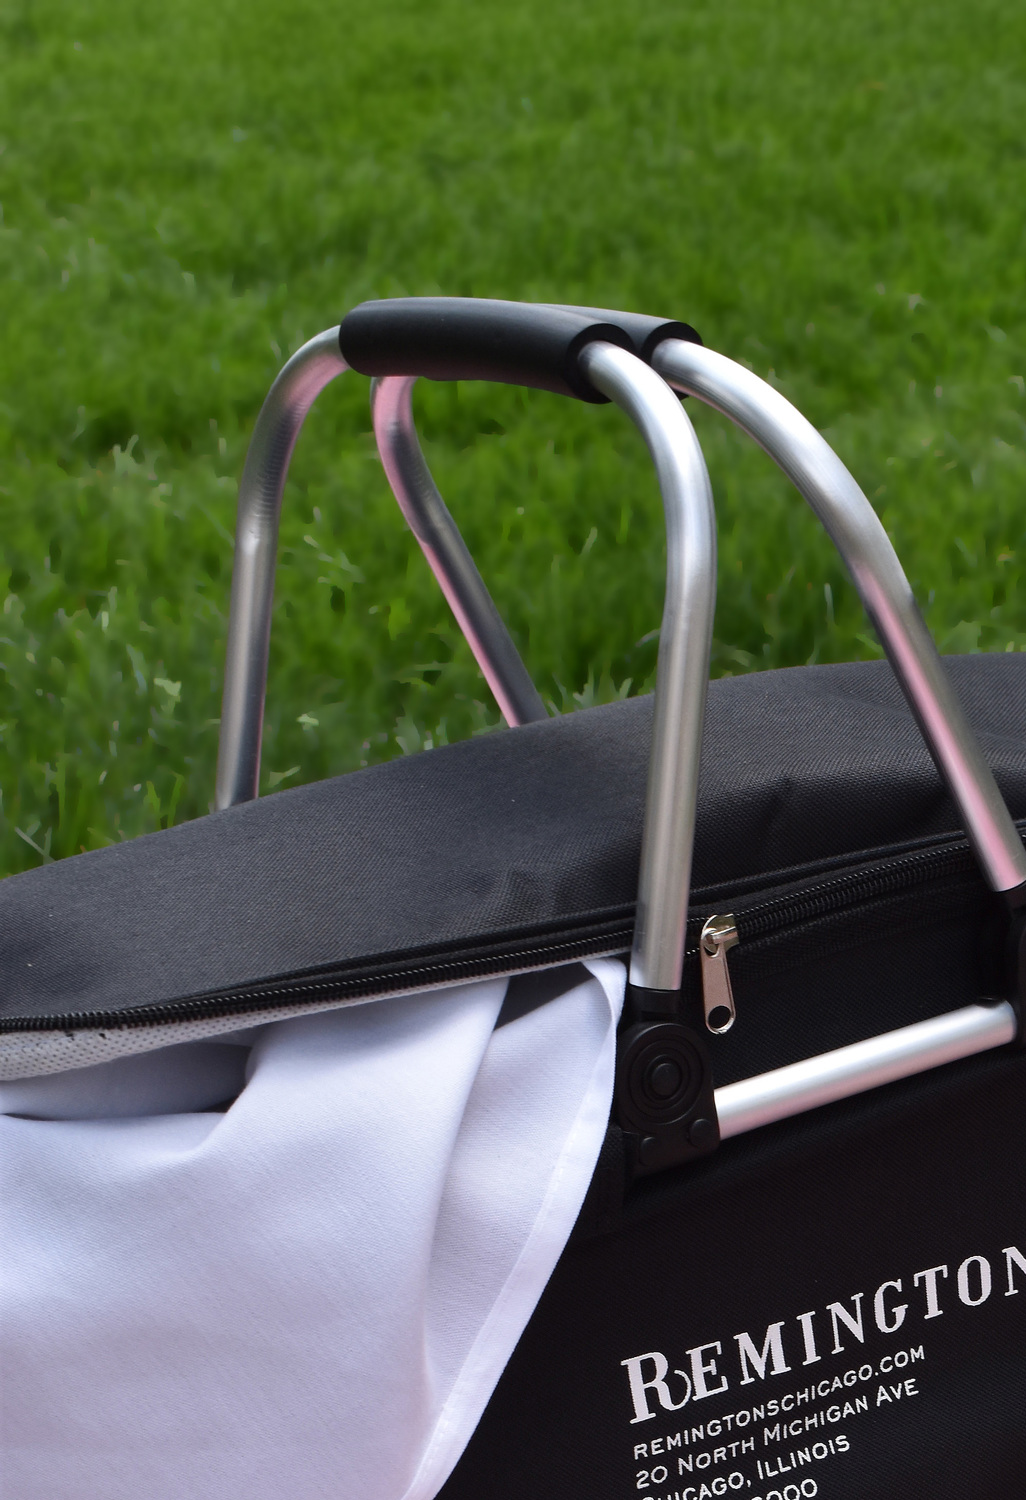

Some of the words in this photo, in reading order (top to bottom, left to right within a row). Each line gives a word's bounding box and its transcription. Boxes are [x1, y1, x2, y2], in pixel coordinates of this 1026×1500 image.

[634, 1345, 925, 1460] REMINGTONSCHICAGO.COM
[636, 1466, 668, 1489] 20
[678, 1437, 755, 1475] NORTH
[764, 1396, 869, 1446] MICHIGAN
[876, 1379, 919, 1406] AVE
[757, 1434, 850, 1479] ILLINOIS
